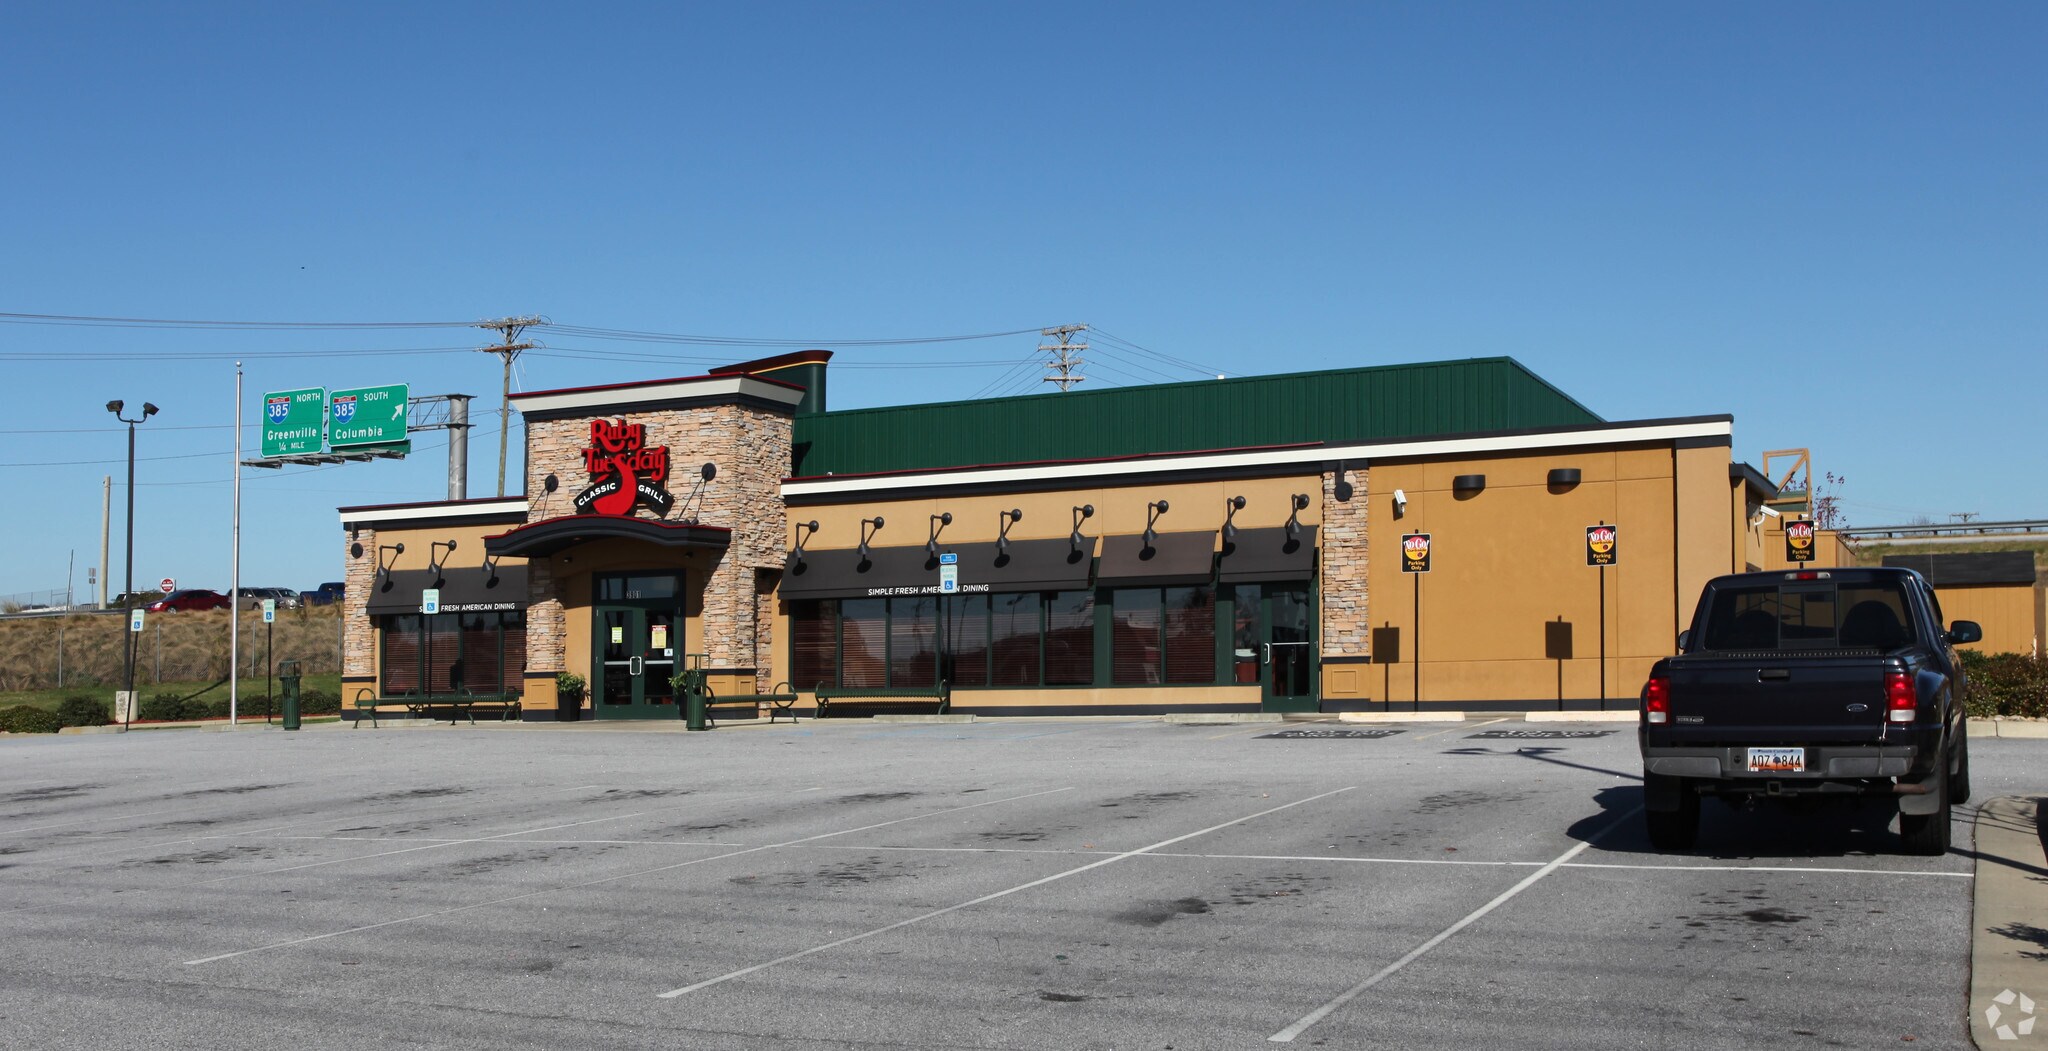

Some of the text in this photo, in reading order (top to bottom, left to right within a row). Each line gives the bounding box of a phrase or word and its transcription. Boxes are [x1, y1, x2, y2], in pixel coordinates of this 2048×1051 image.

[296, 392, 321, 403] NORTH
[363, 391, 389, 402] SOUTH
[269, 403, 289, 418] 385
[334, 403, 355, 417] 385
[267, 427, 317, 441] Greenville
[335, 425, 383, 440] Columbia
[590, 419, 640, 452] Ruby
[290, 441, 305, 449] MILE
[581, 445, 665, 481] Tuesday
[578, 482, 664, 506] CLASSIC GRILL
[868, 584, 989, 596] SIMPLE FRESH AMERN DINING
[440, 602, 516, 612] FRESH AMERICAN DINING
[1781, 755, 1801, 767] 844
